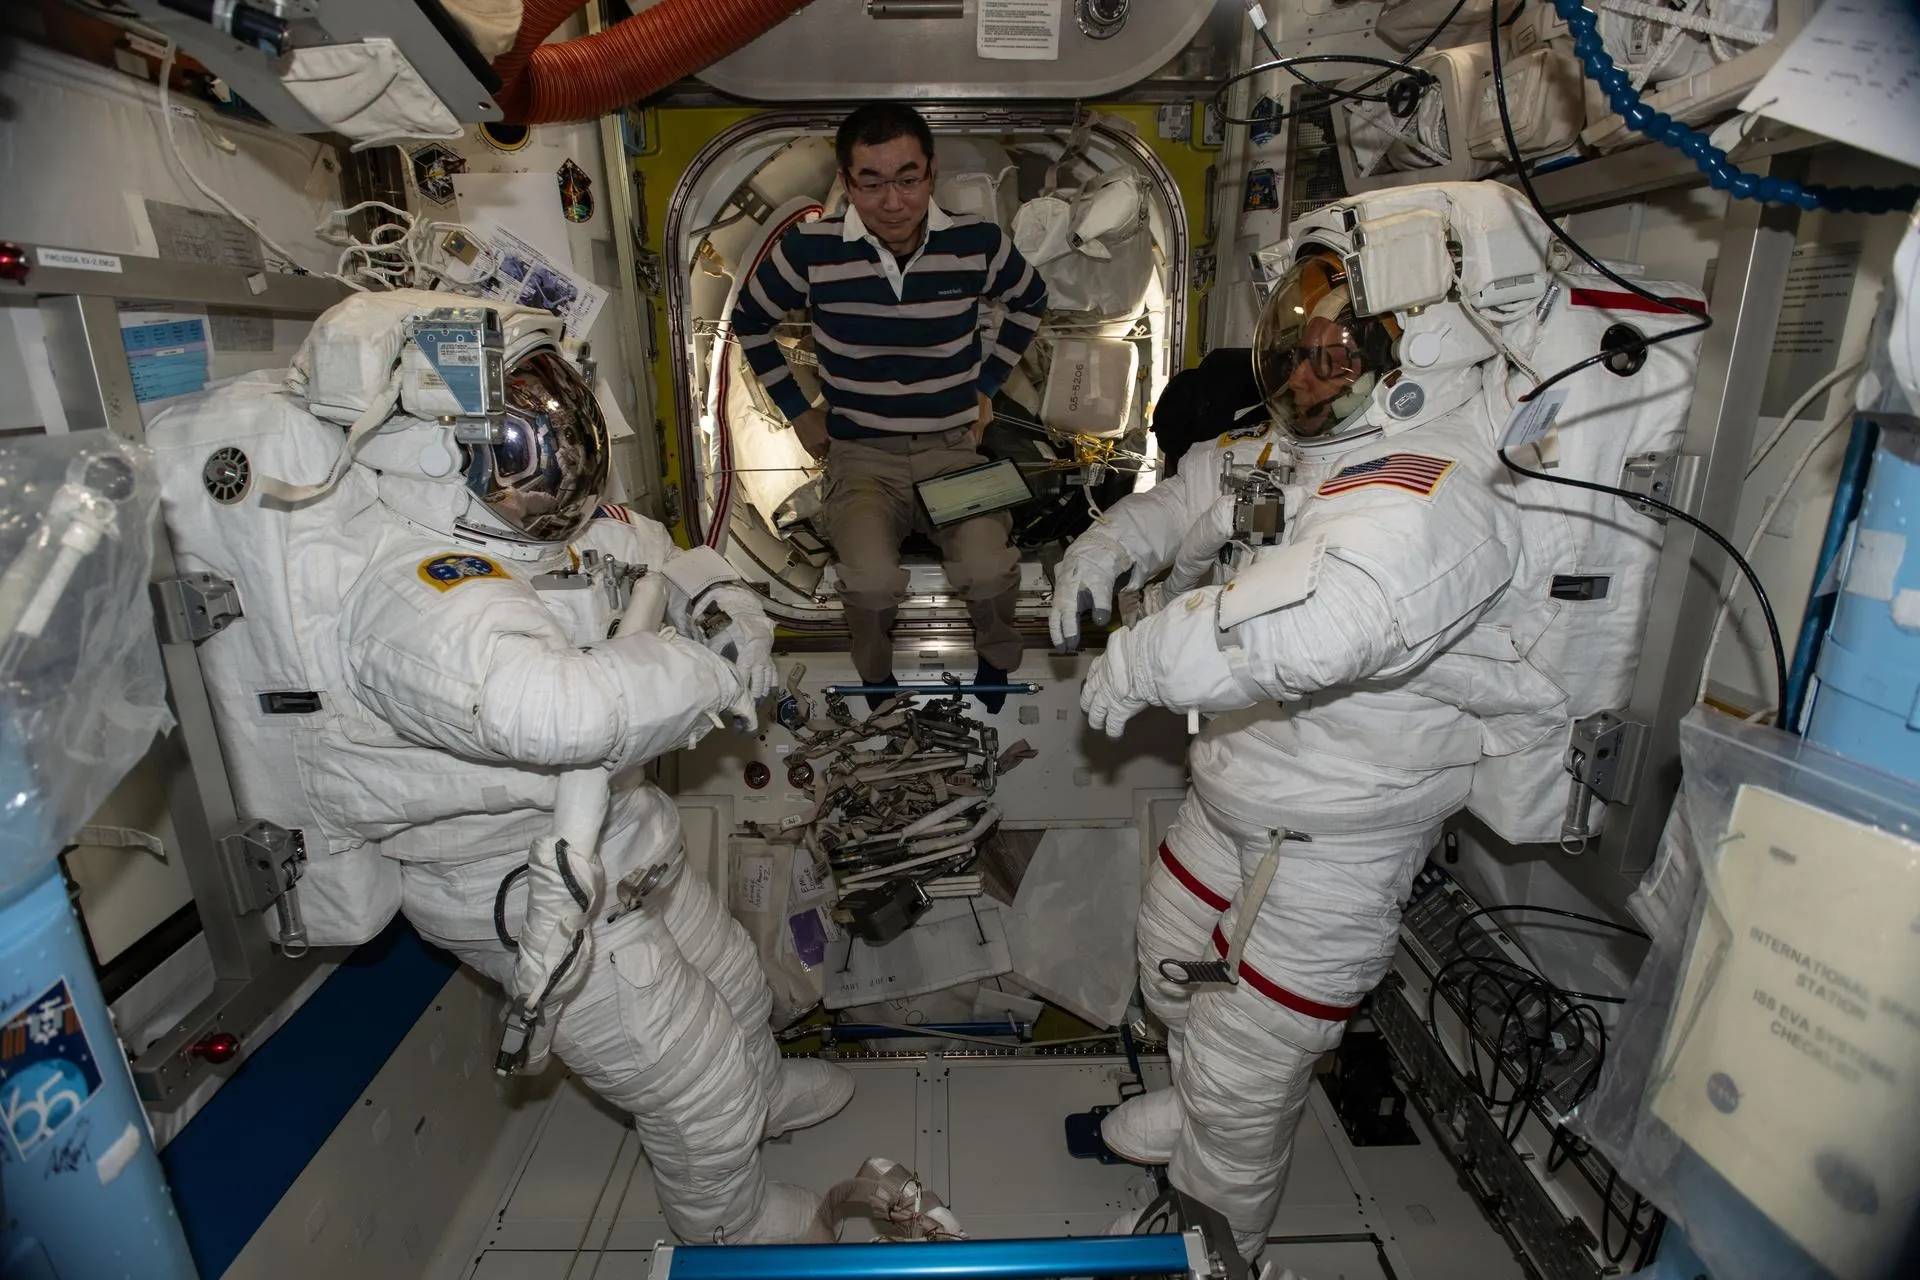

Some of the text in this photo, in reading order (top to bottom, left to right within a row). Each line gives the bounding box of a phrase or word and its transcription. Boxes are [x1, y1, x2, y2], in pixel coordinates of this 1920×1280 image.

[1750, 926, 1869, 1003] INTERNATIONAL
[1752, 988, 1777, 1012] ISS
[1779, 1003, 1810, 1033] EVA
[1796, 972, 1869, 1023] STATION
[6, 1071, 81, 1150] 65
